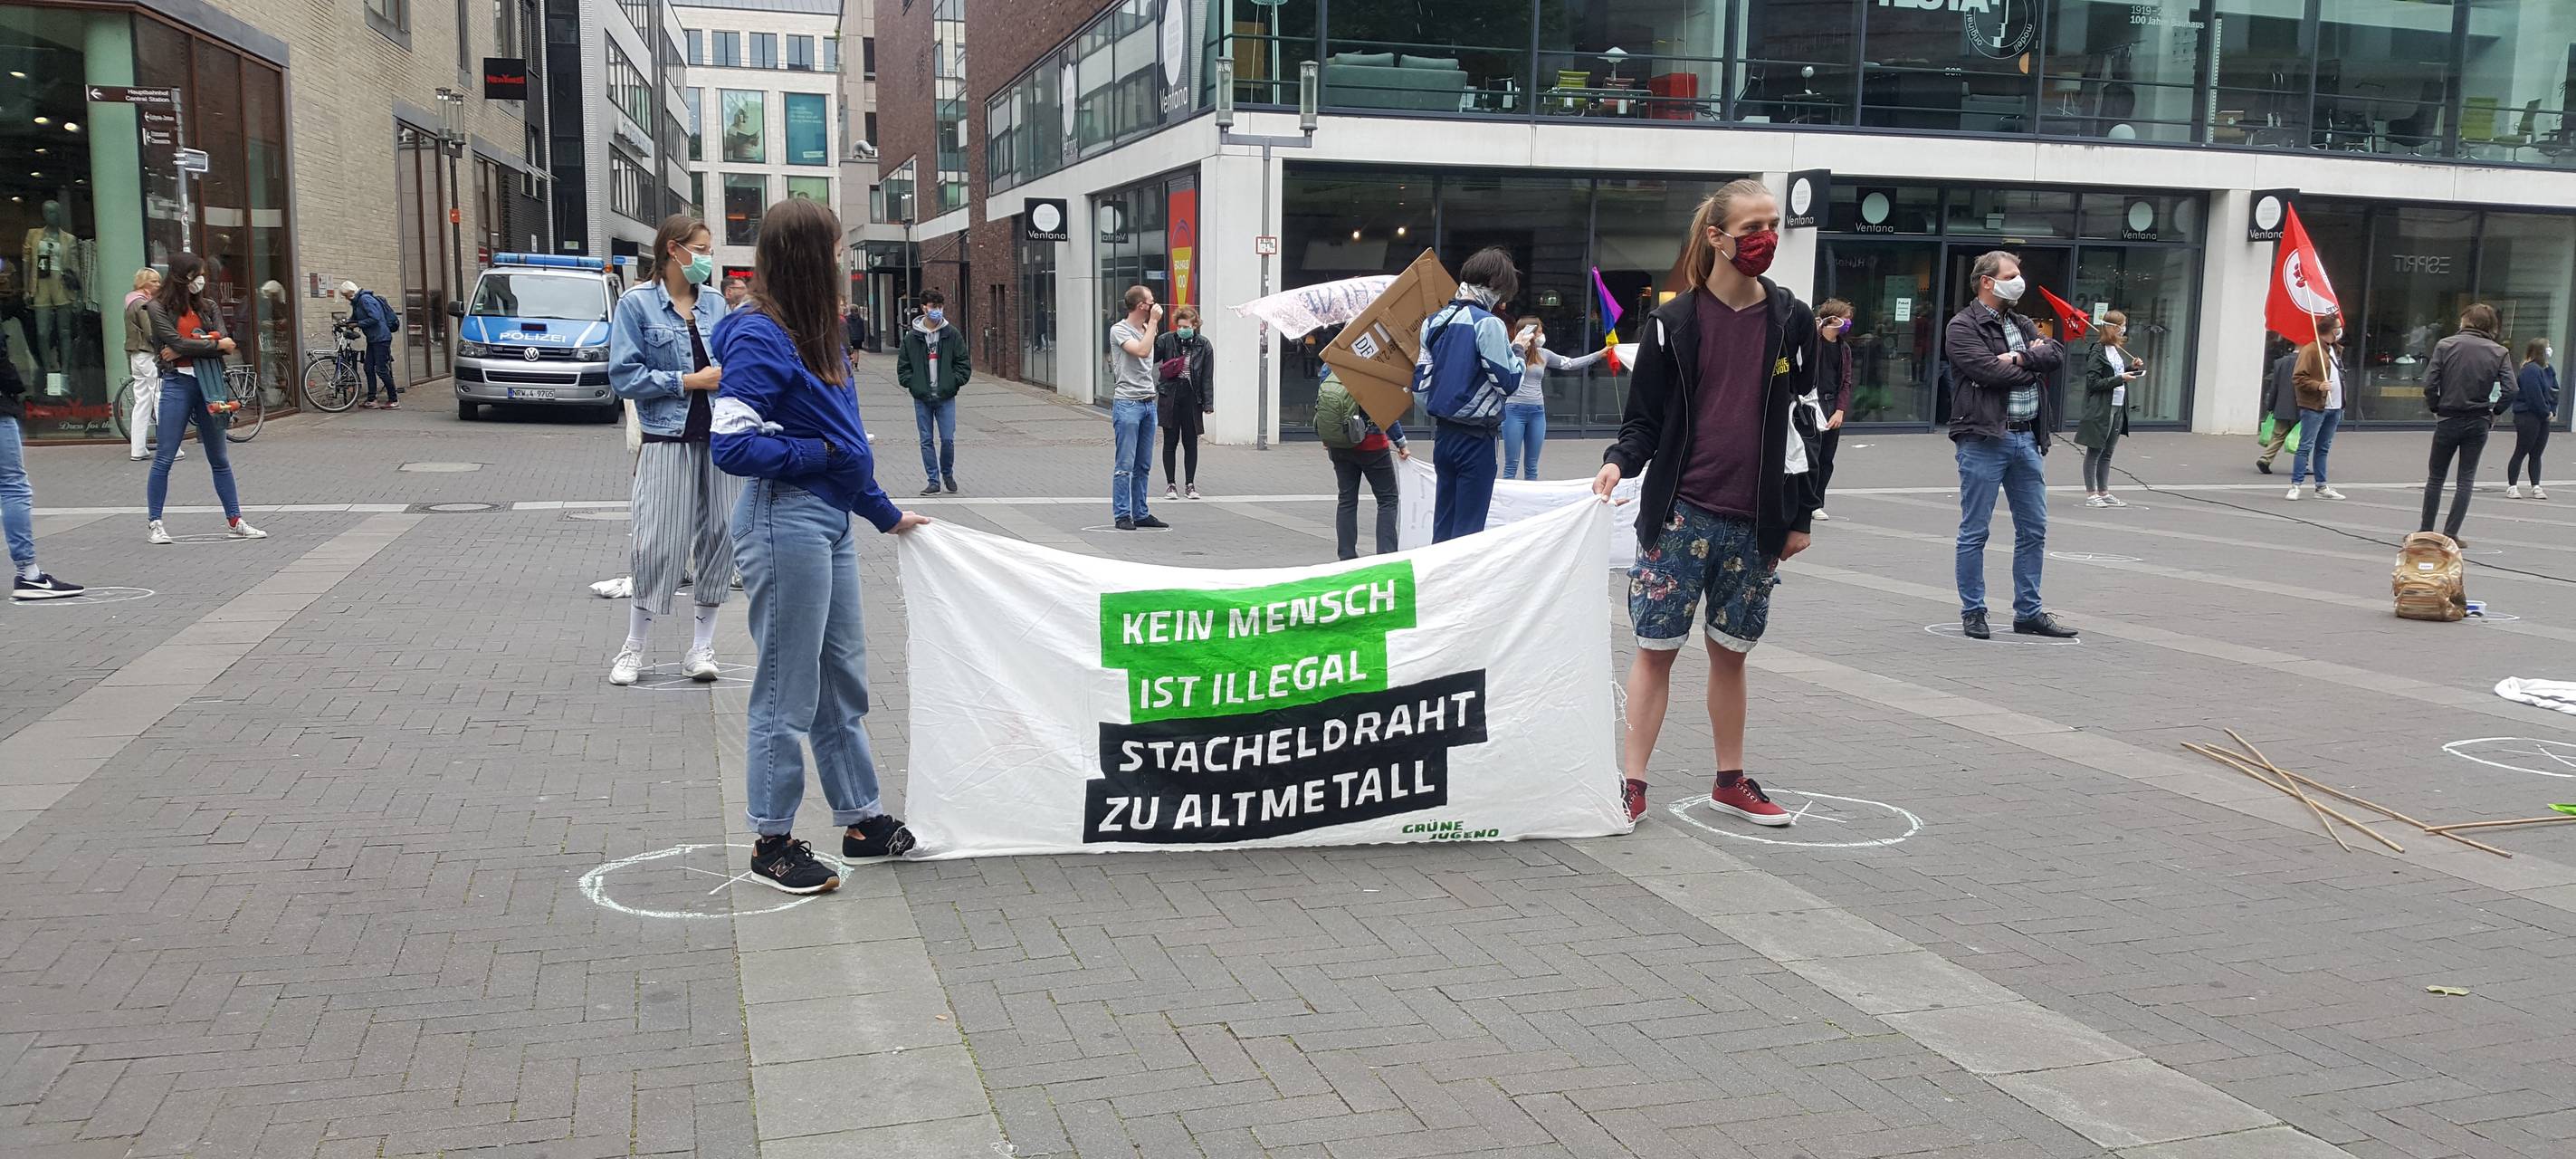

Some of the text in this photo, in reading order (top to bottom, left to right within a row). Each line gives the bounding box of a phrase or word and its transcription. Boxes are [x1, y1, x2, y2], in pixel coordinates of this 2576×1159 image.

[2130, 15, 2146, 24] 100
[1159, 87, 1188, 114] Ventana
[1786, 215, 1814, 225] Ventana
[1856, 223, 1894, 233] Ventana
[1028, 229, 1066, 240] Ventana
[2123, 230, 2157, 241] Ventana
[500, 332, 566, 343] POLIZEI
[1122, 580, 1395, 645] KEIN MENSCH
[1140, 650, 1368, 709] IST ILLEGAL
[1119, 691, 1475, 772] STACHELDRAHT
[1099, 760, 1435, 832] ZU ALTMETALL
[1402, 819, 1465, 833] GRÜNE
[1429, 829, 1500, 840] JUGEND
